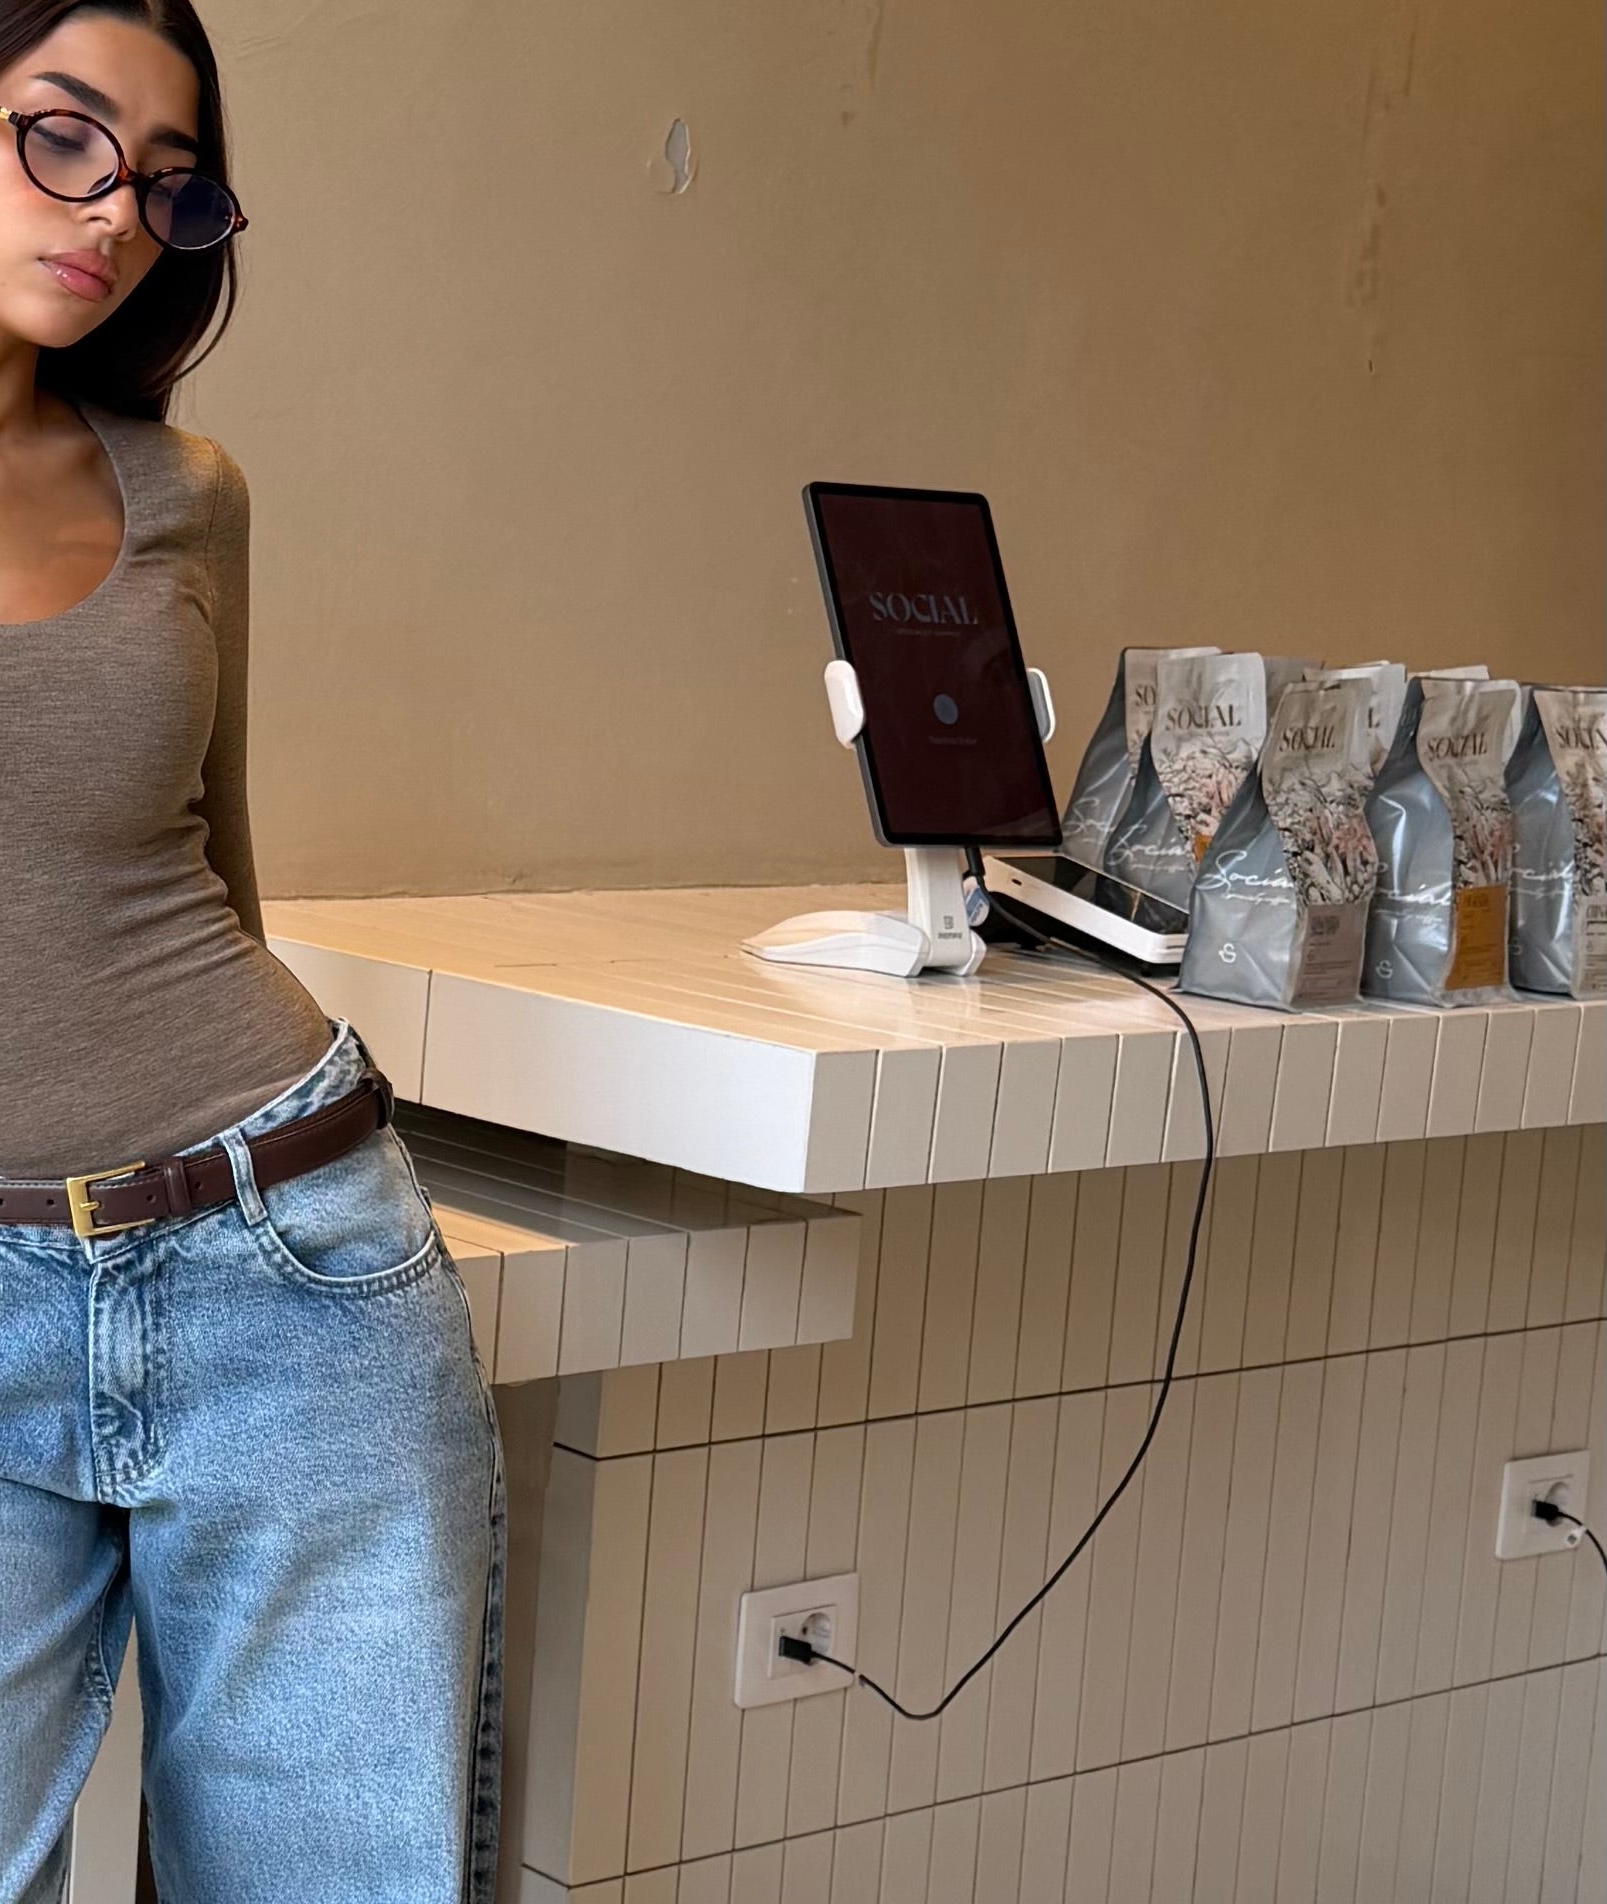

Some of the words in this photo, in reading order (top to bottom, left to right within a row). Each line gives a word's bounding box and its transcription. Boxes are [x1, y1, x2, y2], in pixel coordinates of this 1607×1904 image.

[869, 592, 978, 625] SOCIAL
[1165, 704, 1242, 731] SOCIAL
[1279, 726, 1335, 752] SOCIAL
[1427, 732, 1487, 762] SOCIAL
[1107, 823, 1187, 865] Socia
[1196, 849, 1294, 893] Socia
